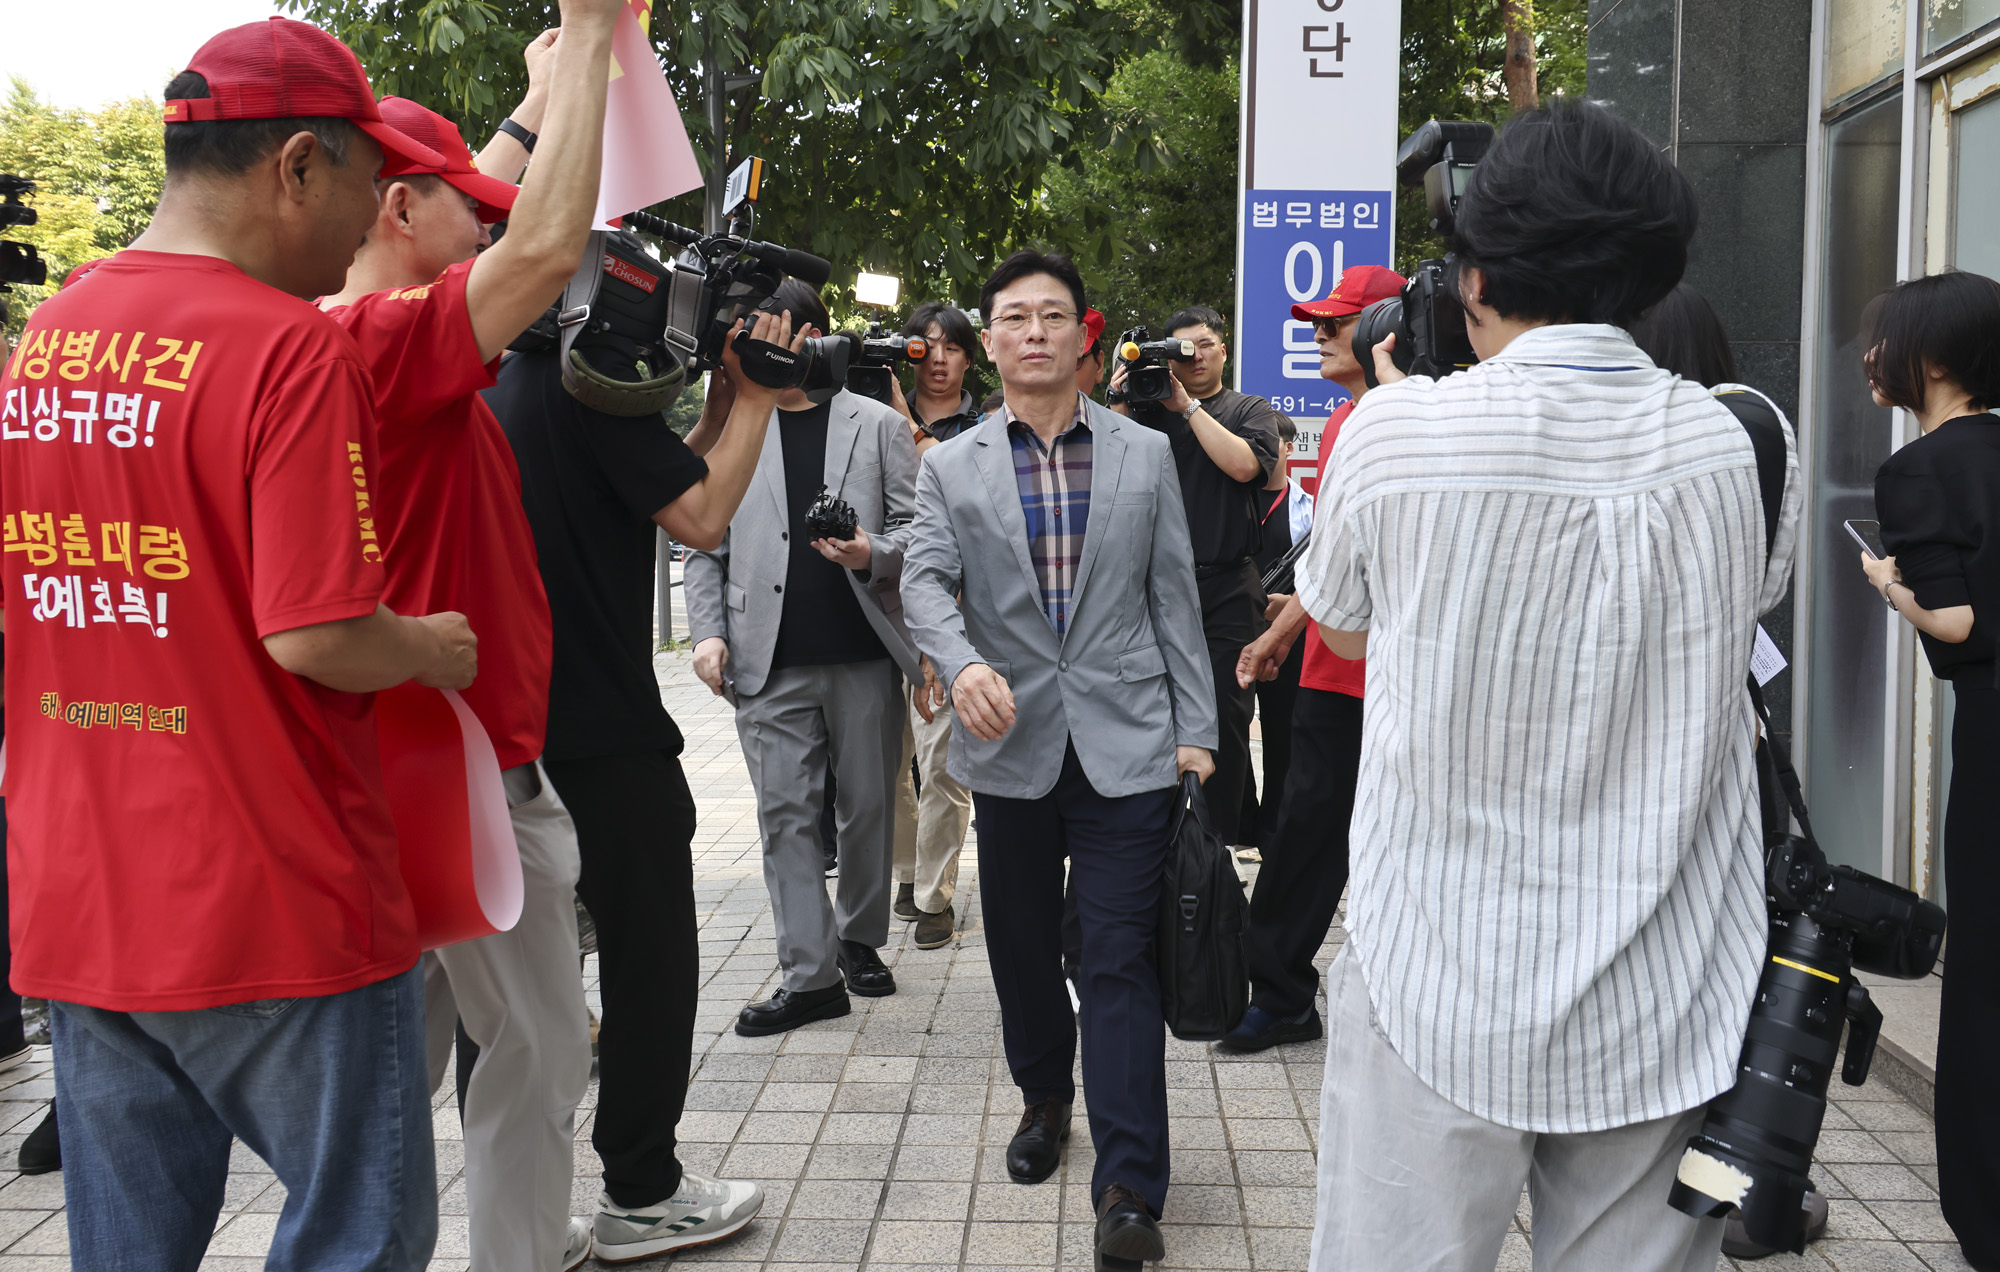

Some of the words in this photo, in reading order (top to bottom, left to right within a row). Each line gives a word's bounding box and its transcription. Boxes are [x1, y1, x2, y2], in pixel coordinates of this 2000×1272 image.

[1253, 201, 1379, 229] 법무법인
[614, 267, 653, 291] CHOSUN
[617, 261, 630, 270] TV
[765, 351, 795, 364] FUJINON
[2, 386, 161, 448] 진상규명!
[347, 441, 382, 562] ROKMC
[101, 522, 190, 580] 대령
